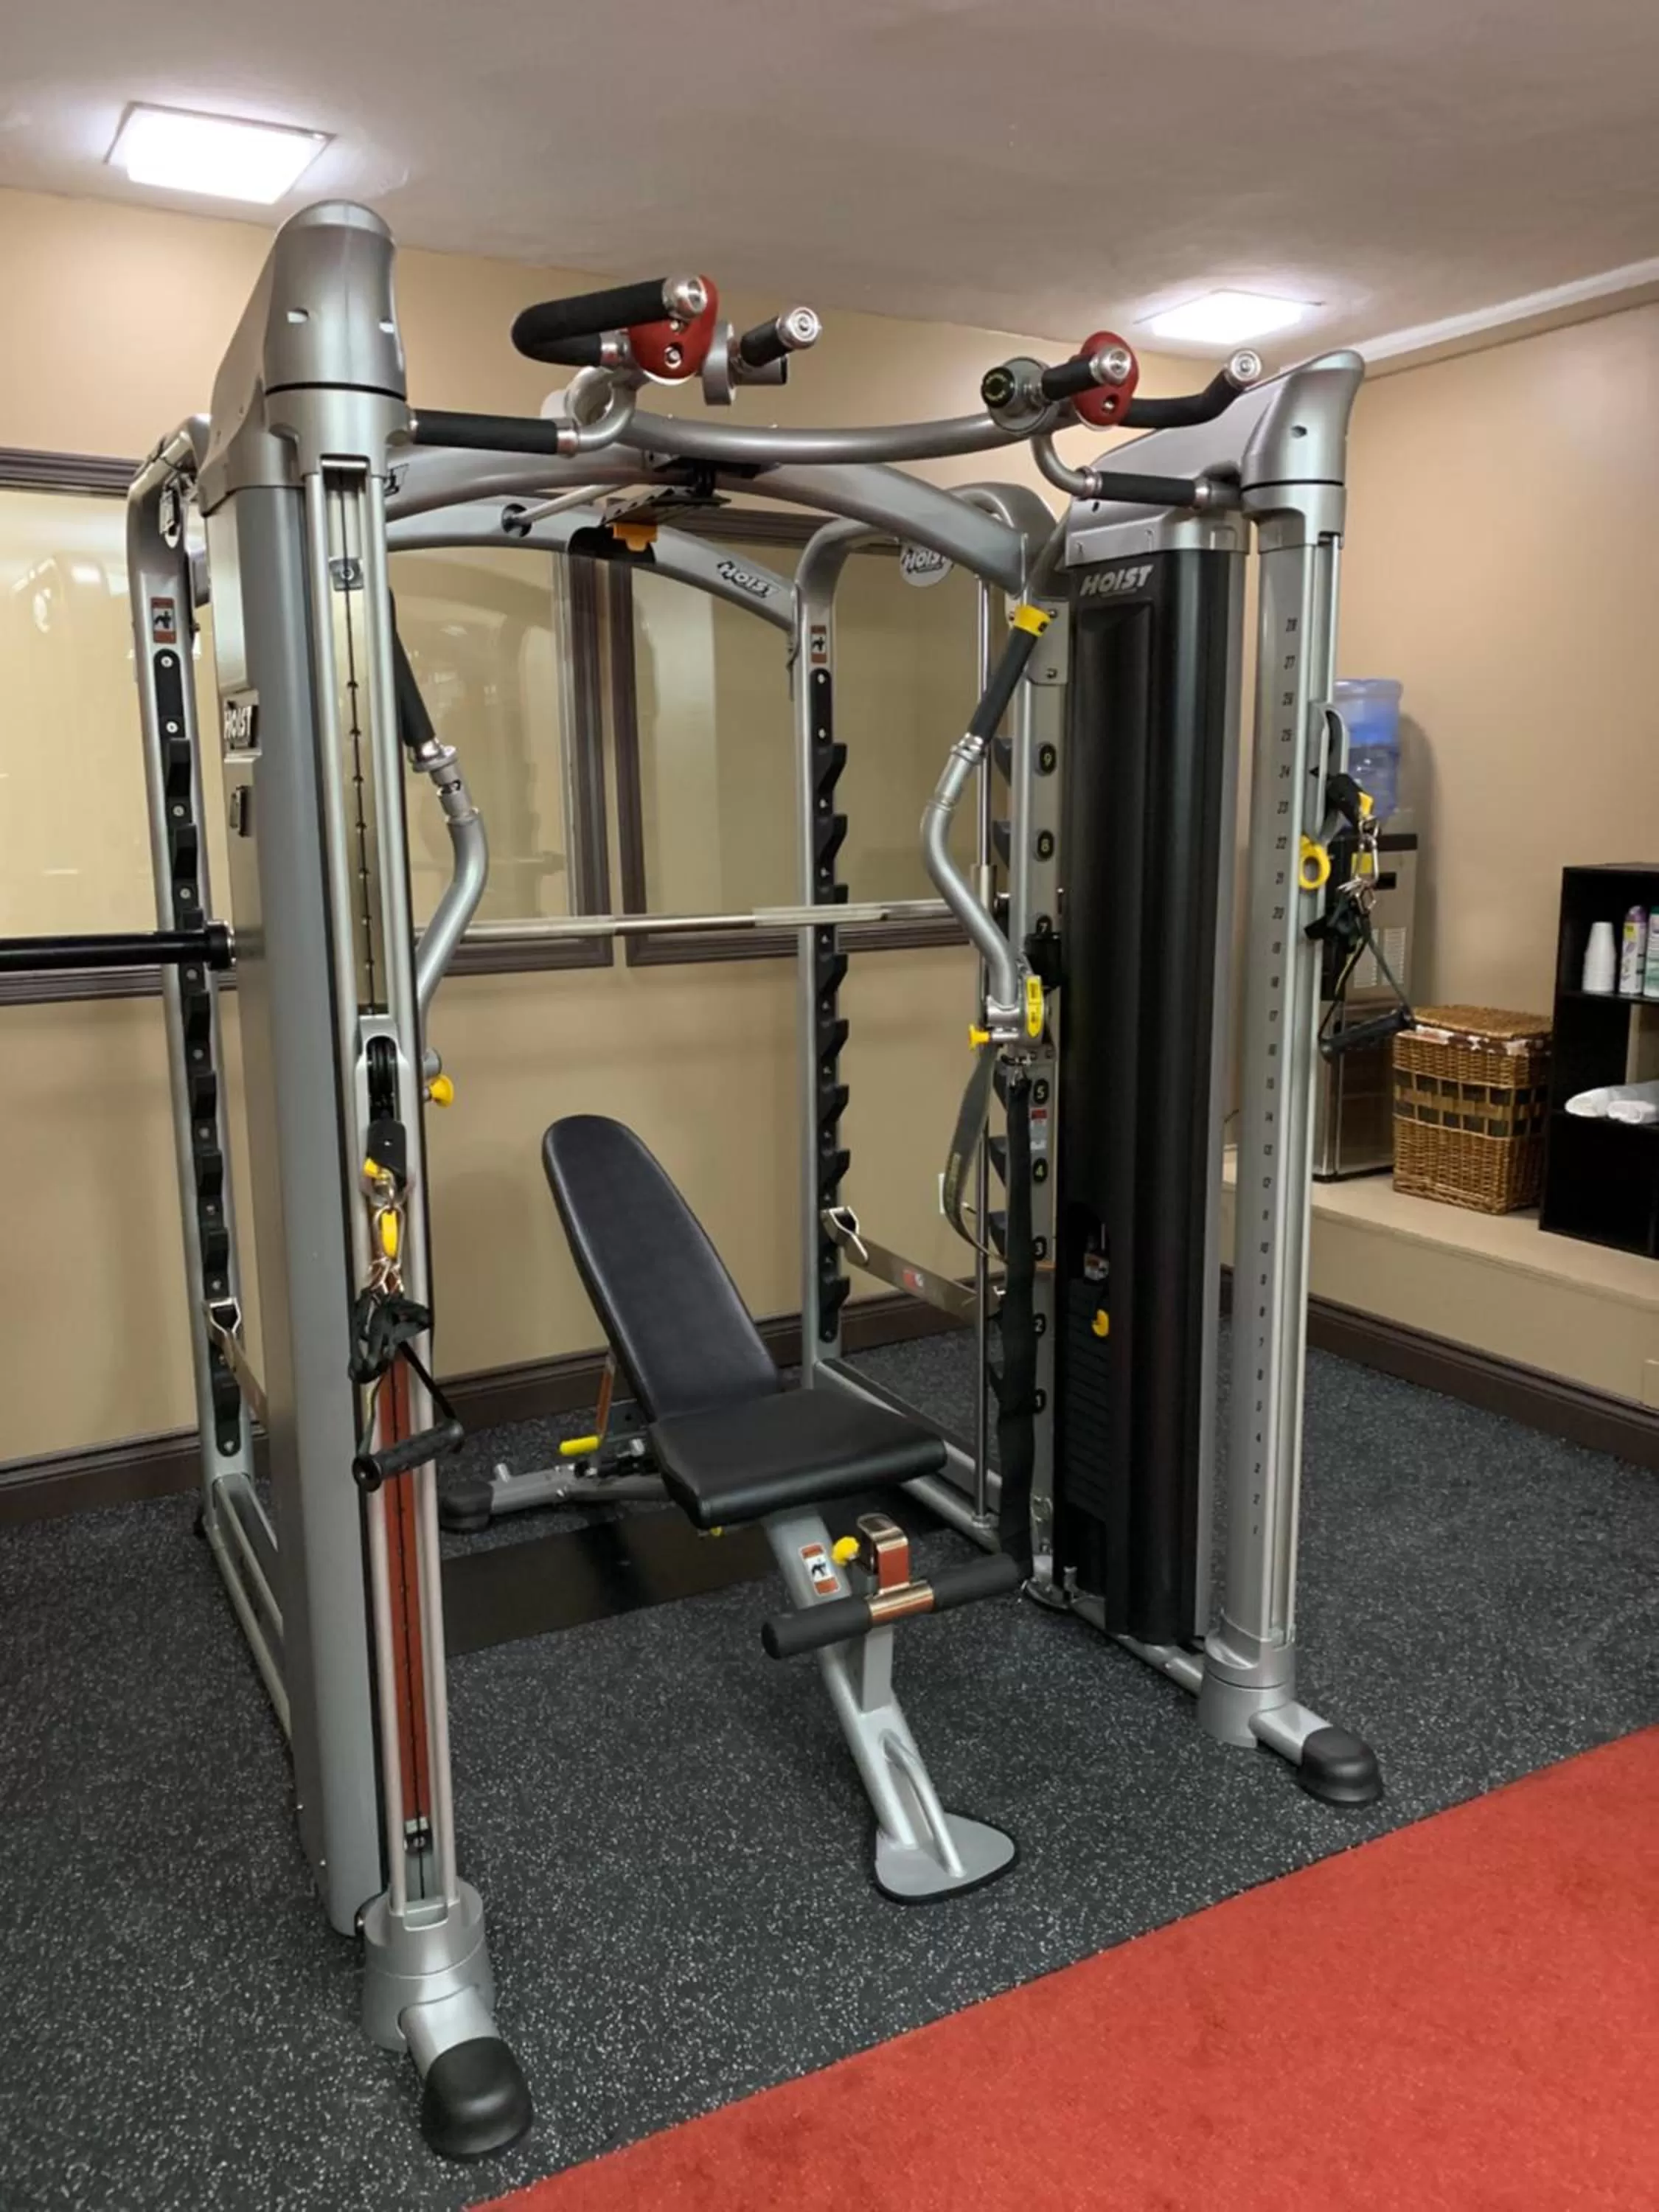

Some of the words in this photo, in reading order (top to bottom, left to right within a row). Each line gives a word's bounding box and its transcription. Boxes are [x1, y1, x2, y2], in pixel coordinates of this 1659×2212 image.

[904, 552, 947, 571] HOIS
[718, 562, 779, 596] HOIST
[1079, 564, 1154, 597] HOIST
[1284, 654, 1296, 669] 27
[223, 705, 252, 740] HOIST
[1281, 728, 1293, 742] 25
[1043, 752, 1053, 767] 9
[1279, 765, 1291, 779] 24
[1277, 800, 1290, 814] 23
[1040, 838, 1050, 853] 8
[1276, 835, 1289, 849] 22
[1272, 905, 1285, 919] 20
[1039, 922, 1048, 933] 7
[1036, 1085, 1045, 1099] 5
[1035, 1164, 1044, 1177] 4
[1034, 1241, 1042, 1253] 3
[1034, 1318, 1043, 1332] 2
[1035, 1394, 1041, 1407] 1
